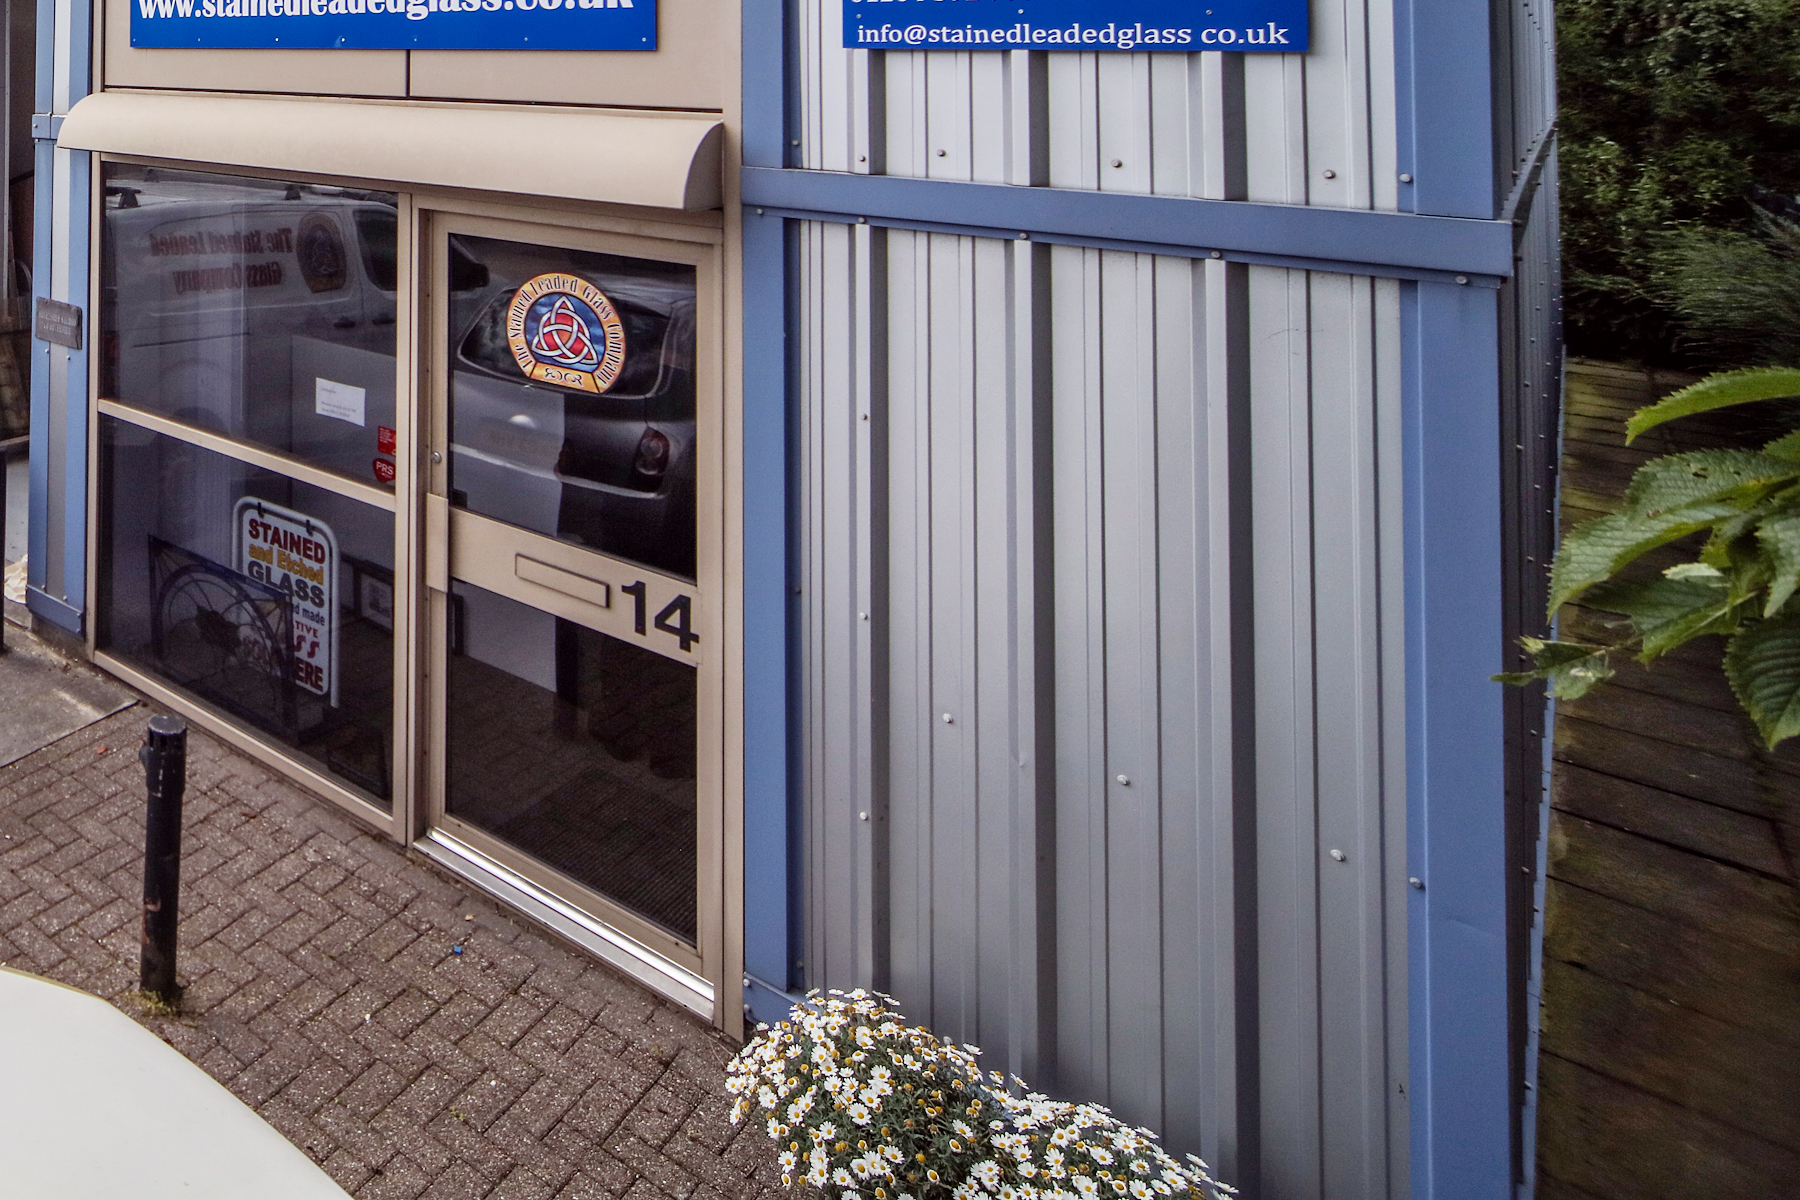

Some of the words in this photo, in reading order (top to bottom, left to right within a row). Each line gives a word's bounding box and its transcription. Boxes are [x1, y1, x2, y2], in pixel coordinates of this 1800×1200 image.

[530, 275, 578, 296] Leaded
[582, 284, 614, 320] Glass
[508, 289, 532, 339] Stained
[514, 343, 533, 371] The
[596, 322, 623, 387] Company
[376, 461, 394, 475] PRS
[248, 518, 326, 565] STAINED
[248, 543, 274, 565] and
[277, 548, 324, 586] Etched
[248, 560, 326, 609] GLASS
[302, 607, 326, 627] made
[621, 580, 700, 653] 14
